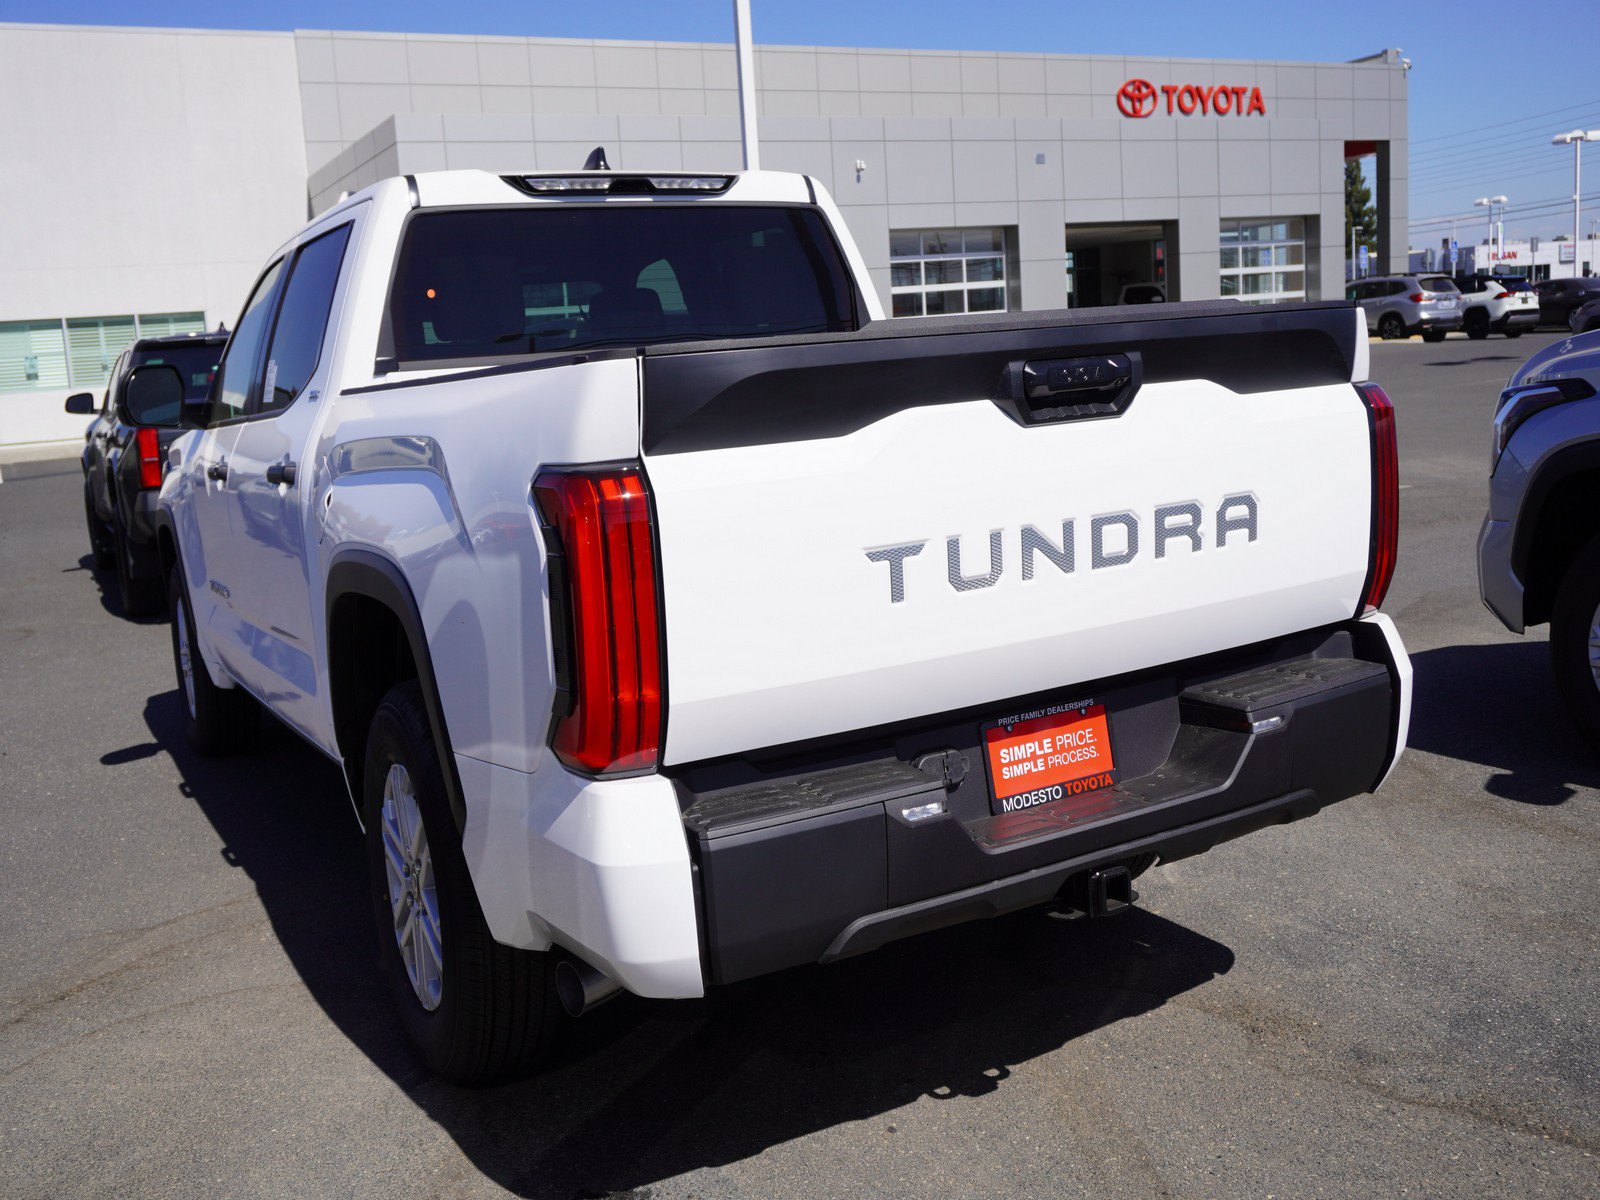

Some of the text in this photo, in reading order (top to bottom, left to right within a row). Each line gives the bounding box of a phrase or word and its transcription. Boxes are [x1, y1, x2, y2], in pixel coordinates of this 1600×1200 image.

[1161, 84, 1266, 116] TOYOTA
[1488, 251, 1517, 261] NISAN
[862, 489, 1260, 604] TUNDRA
[998, 698, 1094, 726] PRICE FAMILY DEALERSHIPS
[1000, 728, 1098, 764] SIMPLE PRICE.
[1002, 746, 1100, 780] SIMPLE PROCESS.
[1002, 773, 1113, 813] MODESTO TOYOTA
